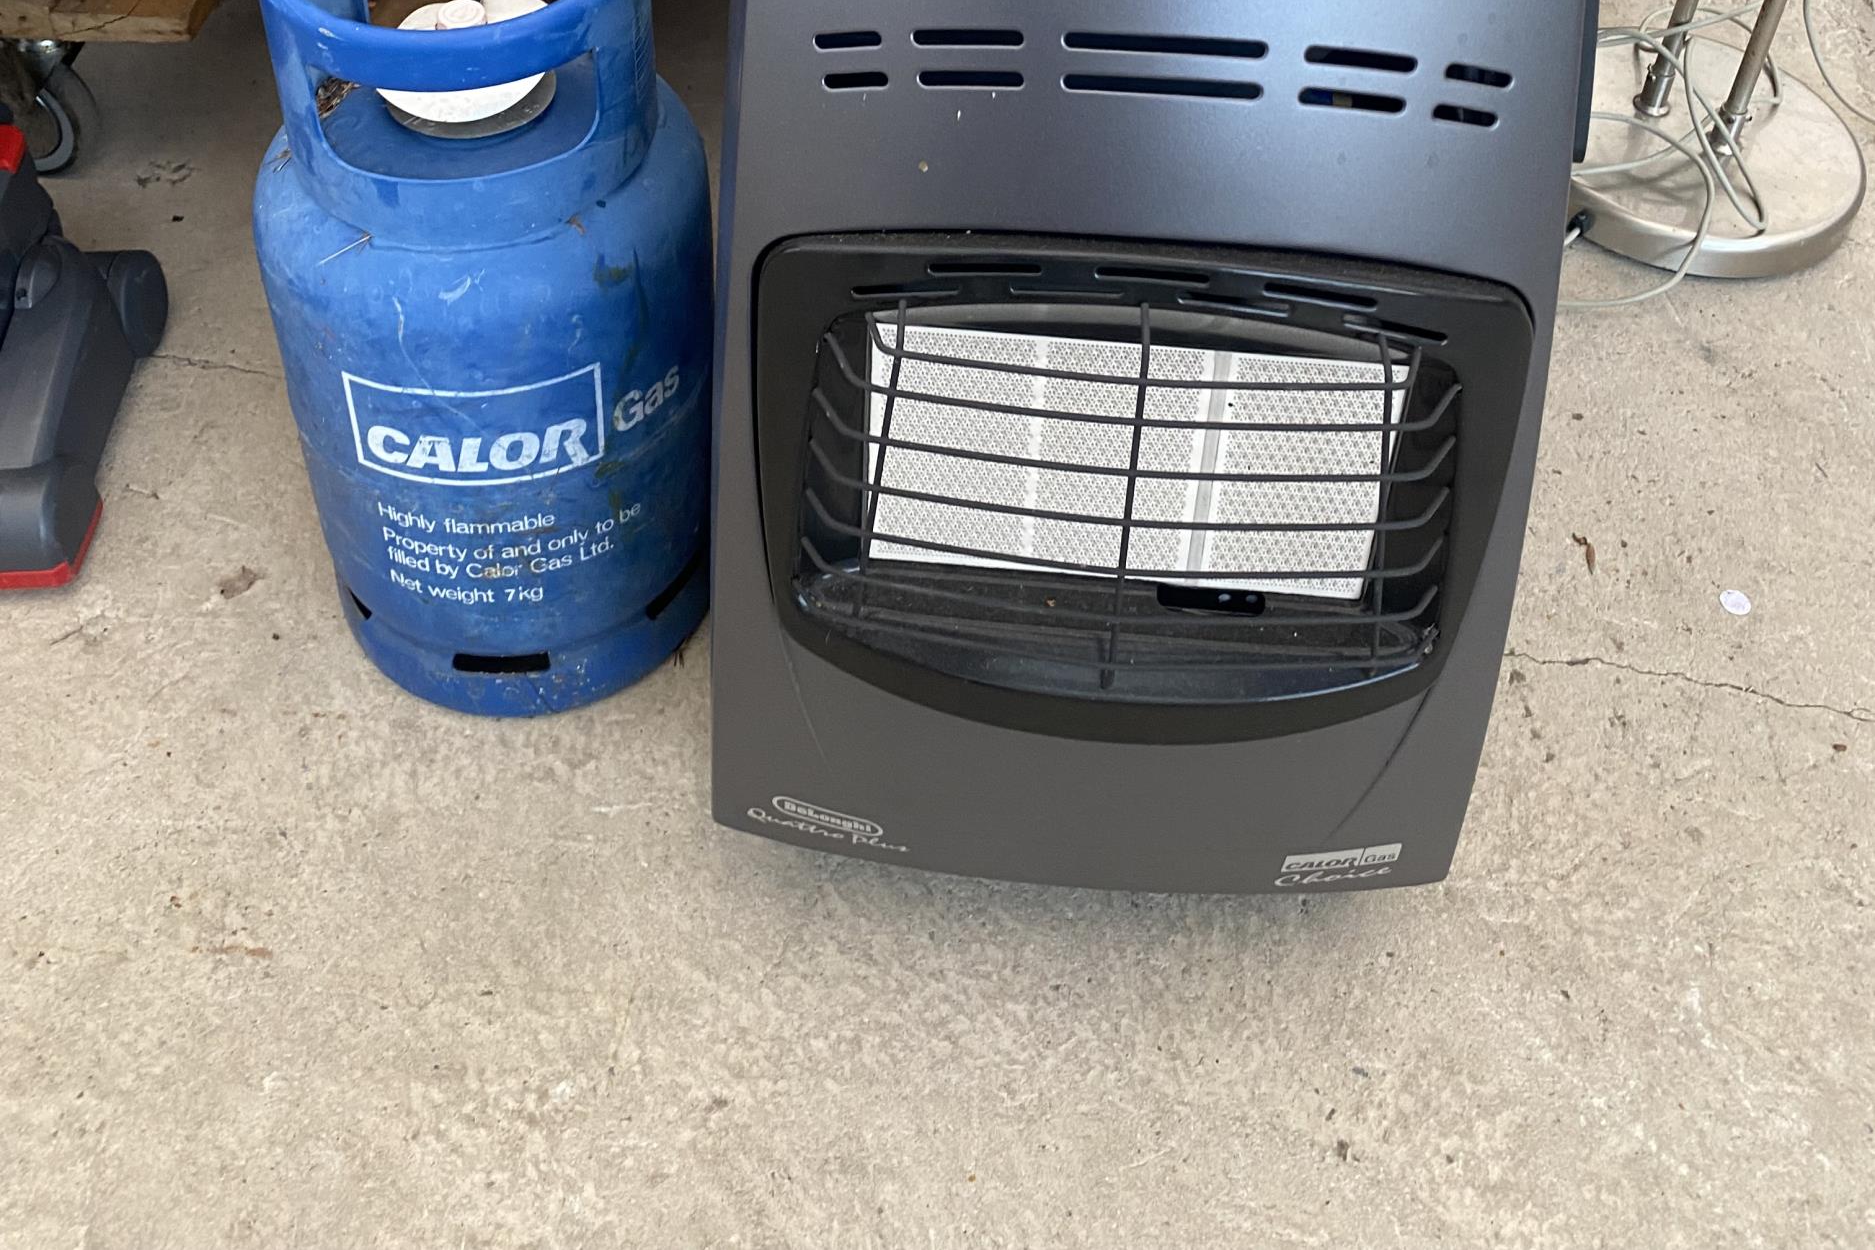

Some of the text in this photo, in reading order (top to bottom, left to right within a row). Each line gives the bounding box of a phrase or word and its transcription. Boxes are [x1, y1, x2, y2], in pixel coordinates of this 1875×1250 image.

[367, 365, 680, 473] CALOR Gas
[378, 501, 556, 534] Highly flammable
[382, 502, 641, 562] Property of and only to be
[387, 536, 615, 579] filled by Calor Gas Ltd.
[390, 568, 423, 593] Net
[428, 586, 495, 604] weight
[784, 800, 872, 833] DeLonghi
[1285, 852, 1396, 870] CALOR Gas
